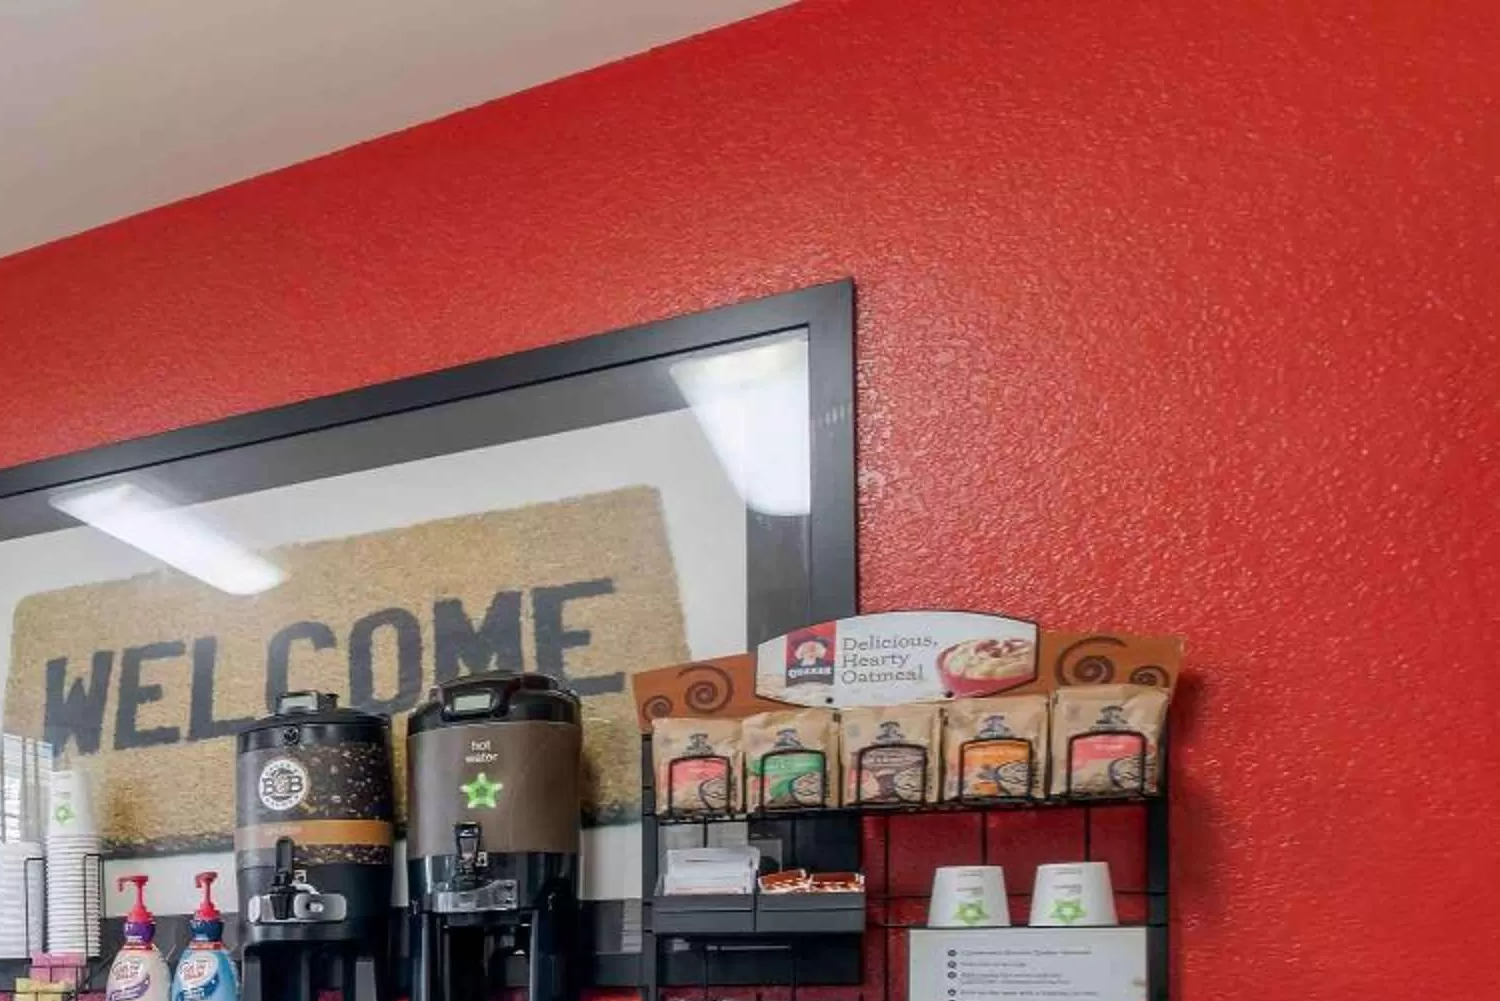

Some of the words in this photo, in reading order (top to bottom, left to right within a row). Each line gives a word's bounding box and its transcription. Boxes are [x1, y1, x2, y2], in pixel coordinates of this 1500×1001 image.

[842, 634, 938, 650] Delicious,
[44, 578, 625, 756] WELCOME
[842, 653, 909, 668] Hearty
[841, 665, 924, 684] Oatmeal
